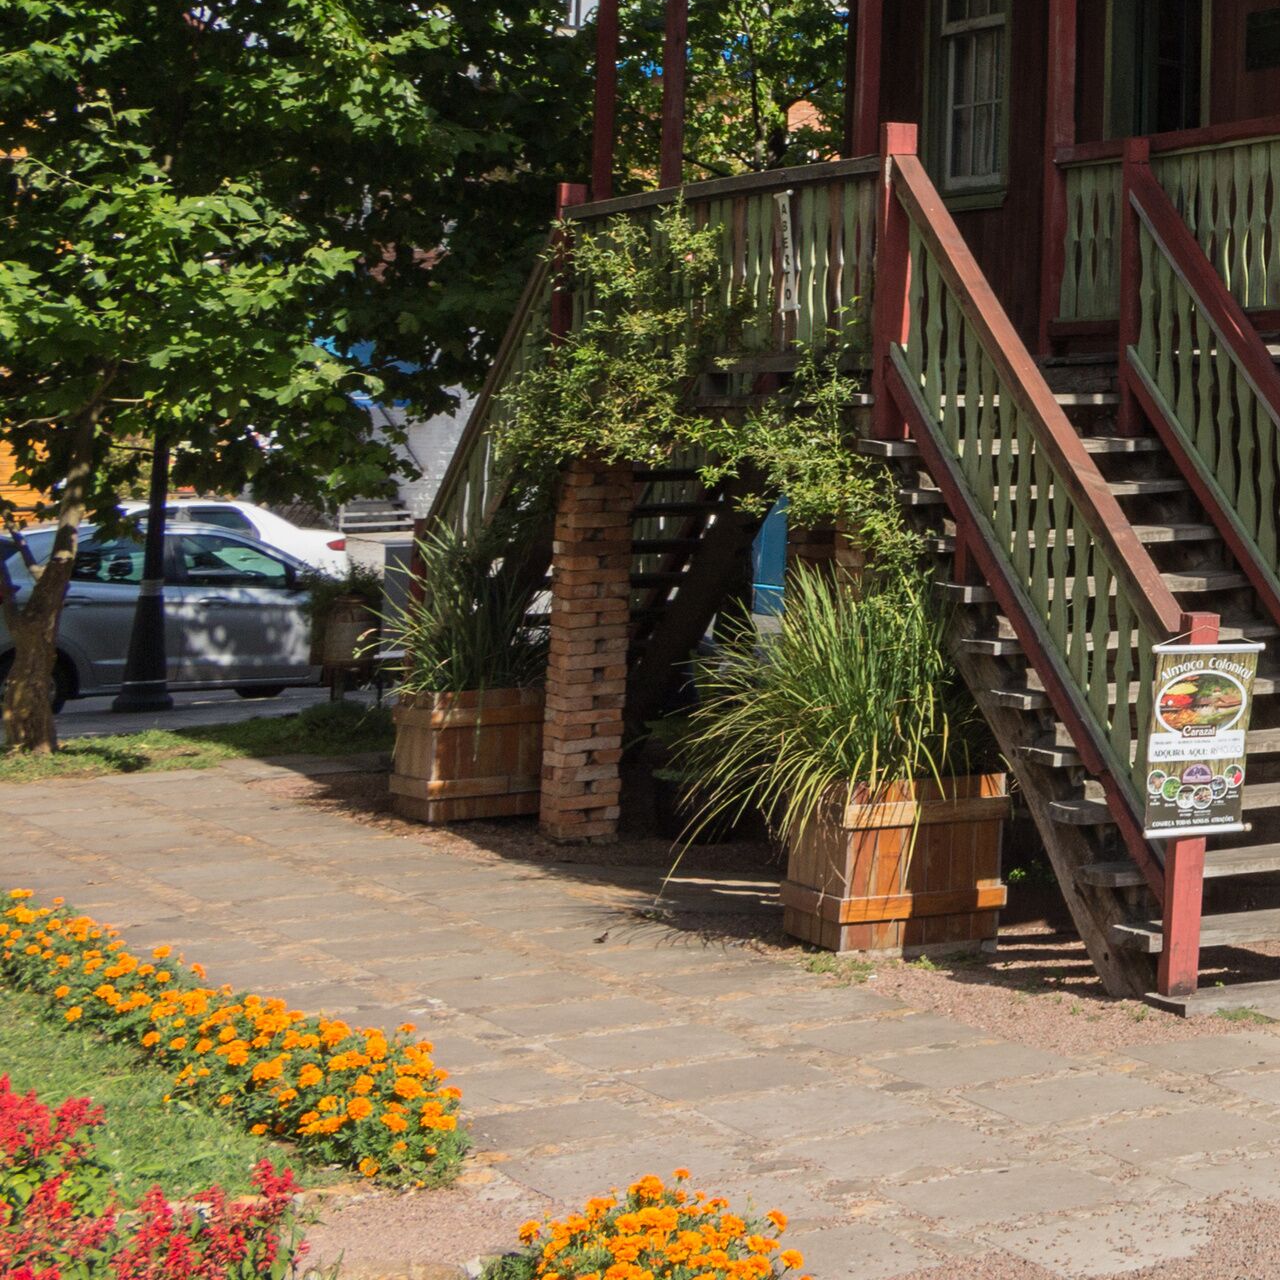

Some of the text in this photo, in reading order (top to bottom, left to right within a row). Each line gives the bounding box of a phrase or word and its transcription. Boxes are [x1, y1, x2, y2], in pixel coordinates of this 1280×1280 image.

[781, 203, 792, 300] ABERTO
[1208, 657, 1254, 680] Colonial
[1182, 725, 1216, 737] Carazal
